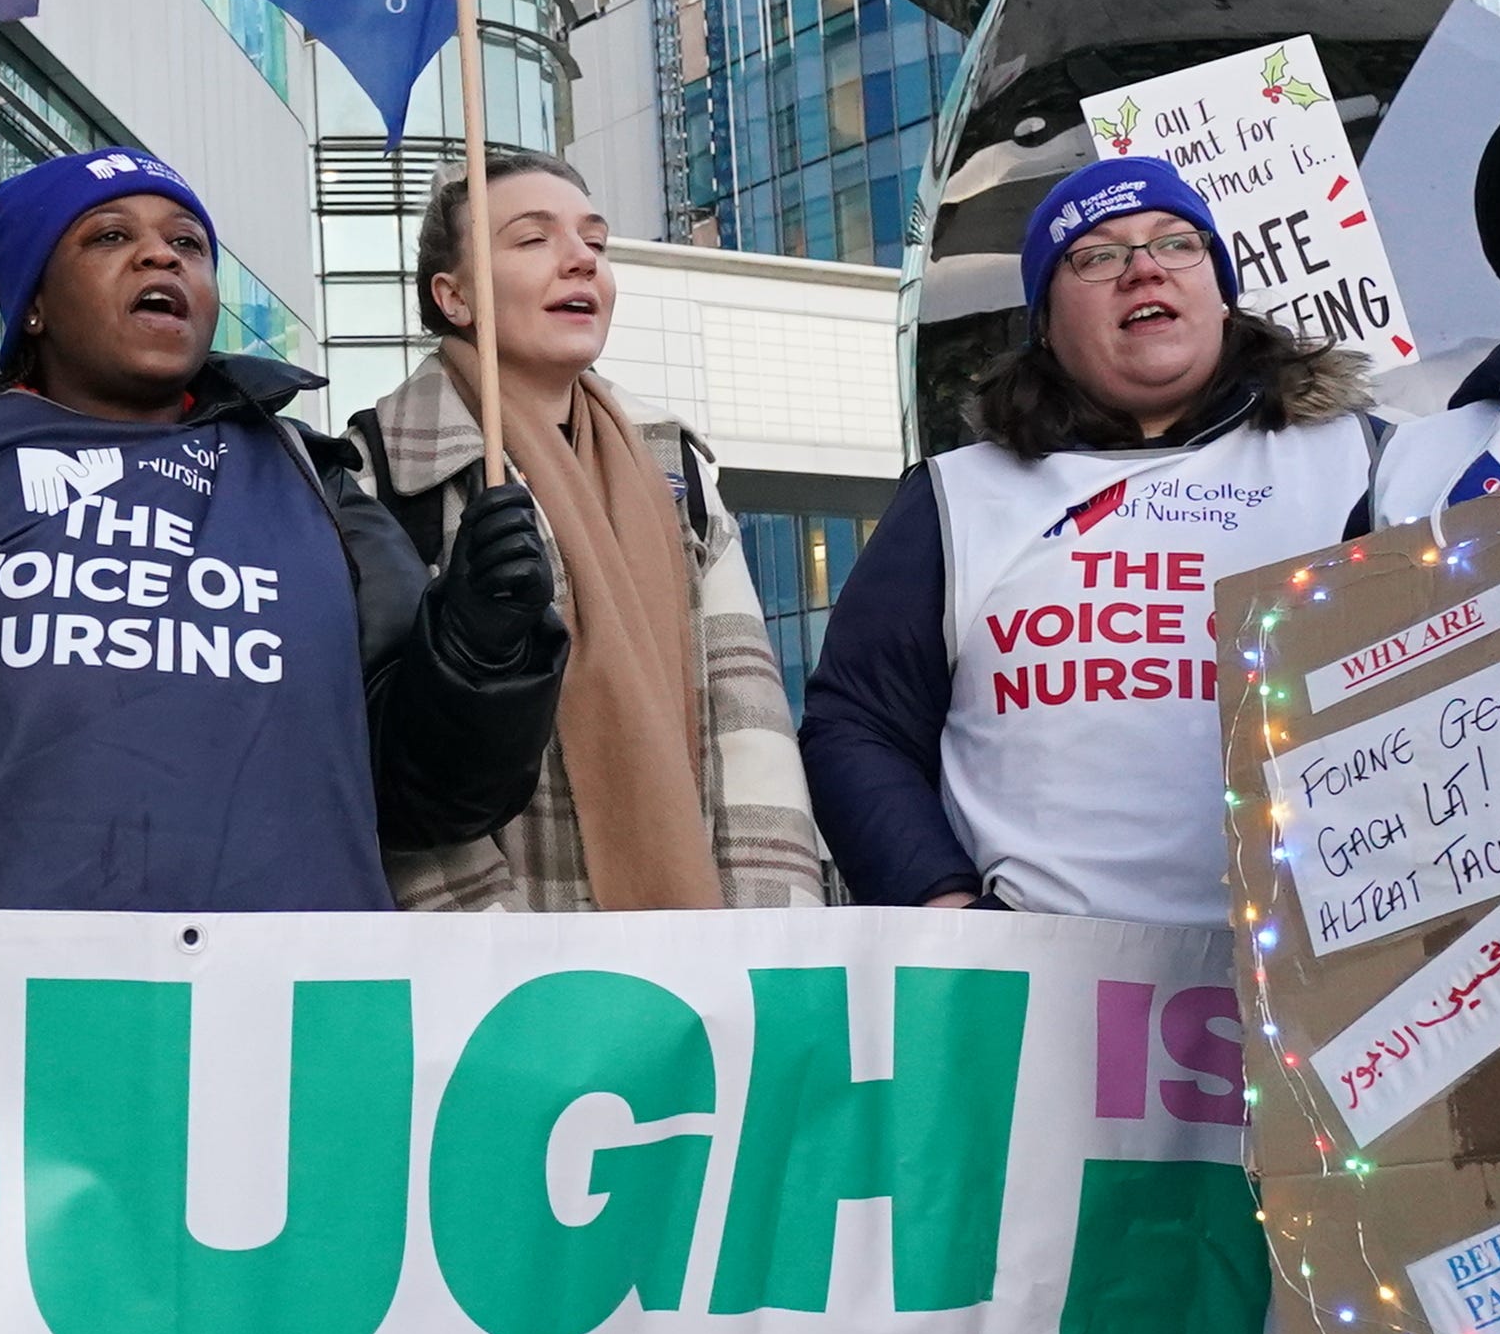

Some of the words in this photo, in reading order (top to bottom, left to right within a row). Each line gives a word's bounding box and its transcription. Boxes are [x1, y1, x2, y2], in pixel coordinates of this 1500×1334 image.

[1154, 106, 1190, 139] all
[1197, 97, 1217, 124] I
[1158, 130, 1226, 167] ant
[1236, 115, 1278, 152] for
[1290, 143, 1336, 175] is...
[1231, 209, 1331, 294] AFE
[1113, 498, 1141, 518] of
[1146, 501, 1239, 532] Nursing
[1185, 483, 1273, 507] College
[65, 495, 195, 557] THE
[186, 556, 279, 615] OF
[1071, 550, 1205, 592] THE
[985, 602, 1186, 655] VOICE
[1341, 631, 1420, 682] WHY
[1421, 598, 1484, 648] ARE
[992, 657, 1217, 715] NURSI
[1095, 979, 1254, 1126] IS
